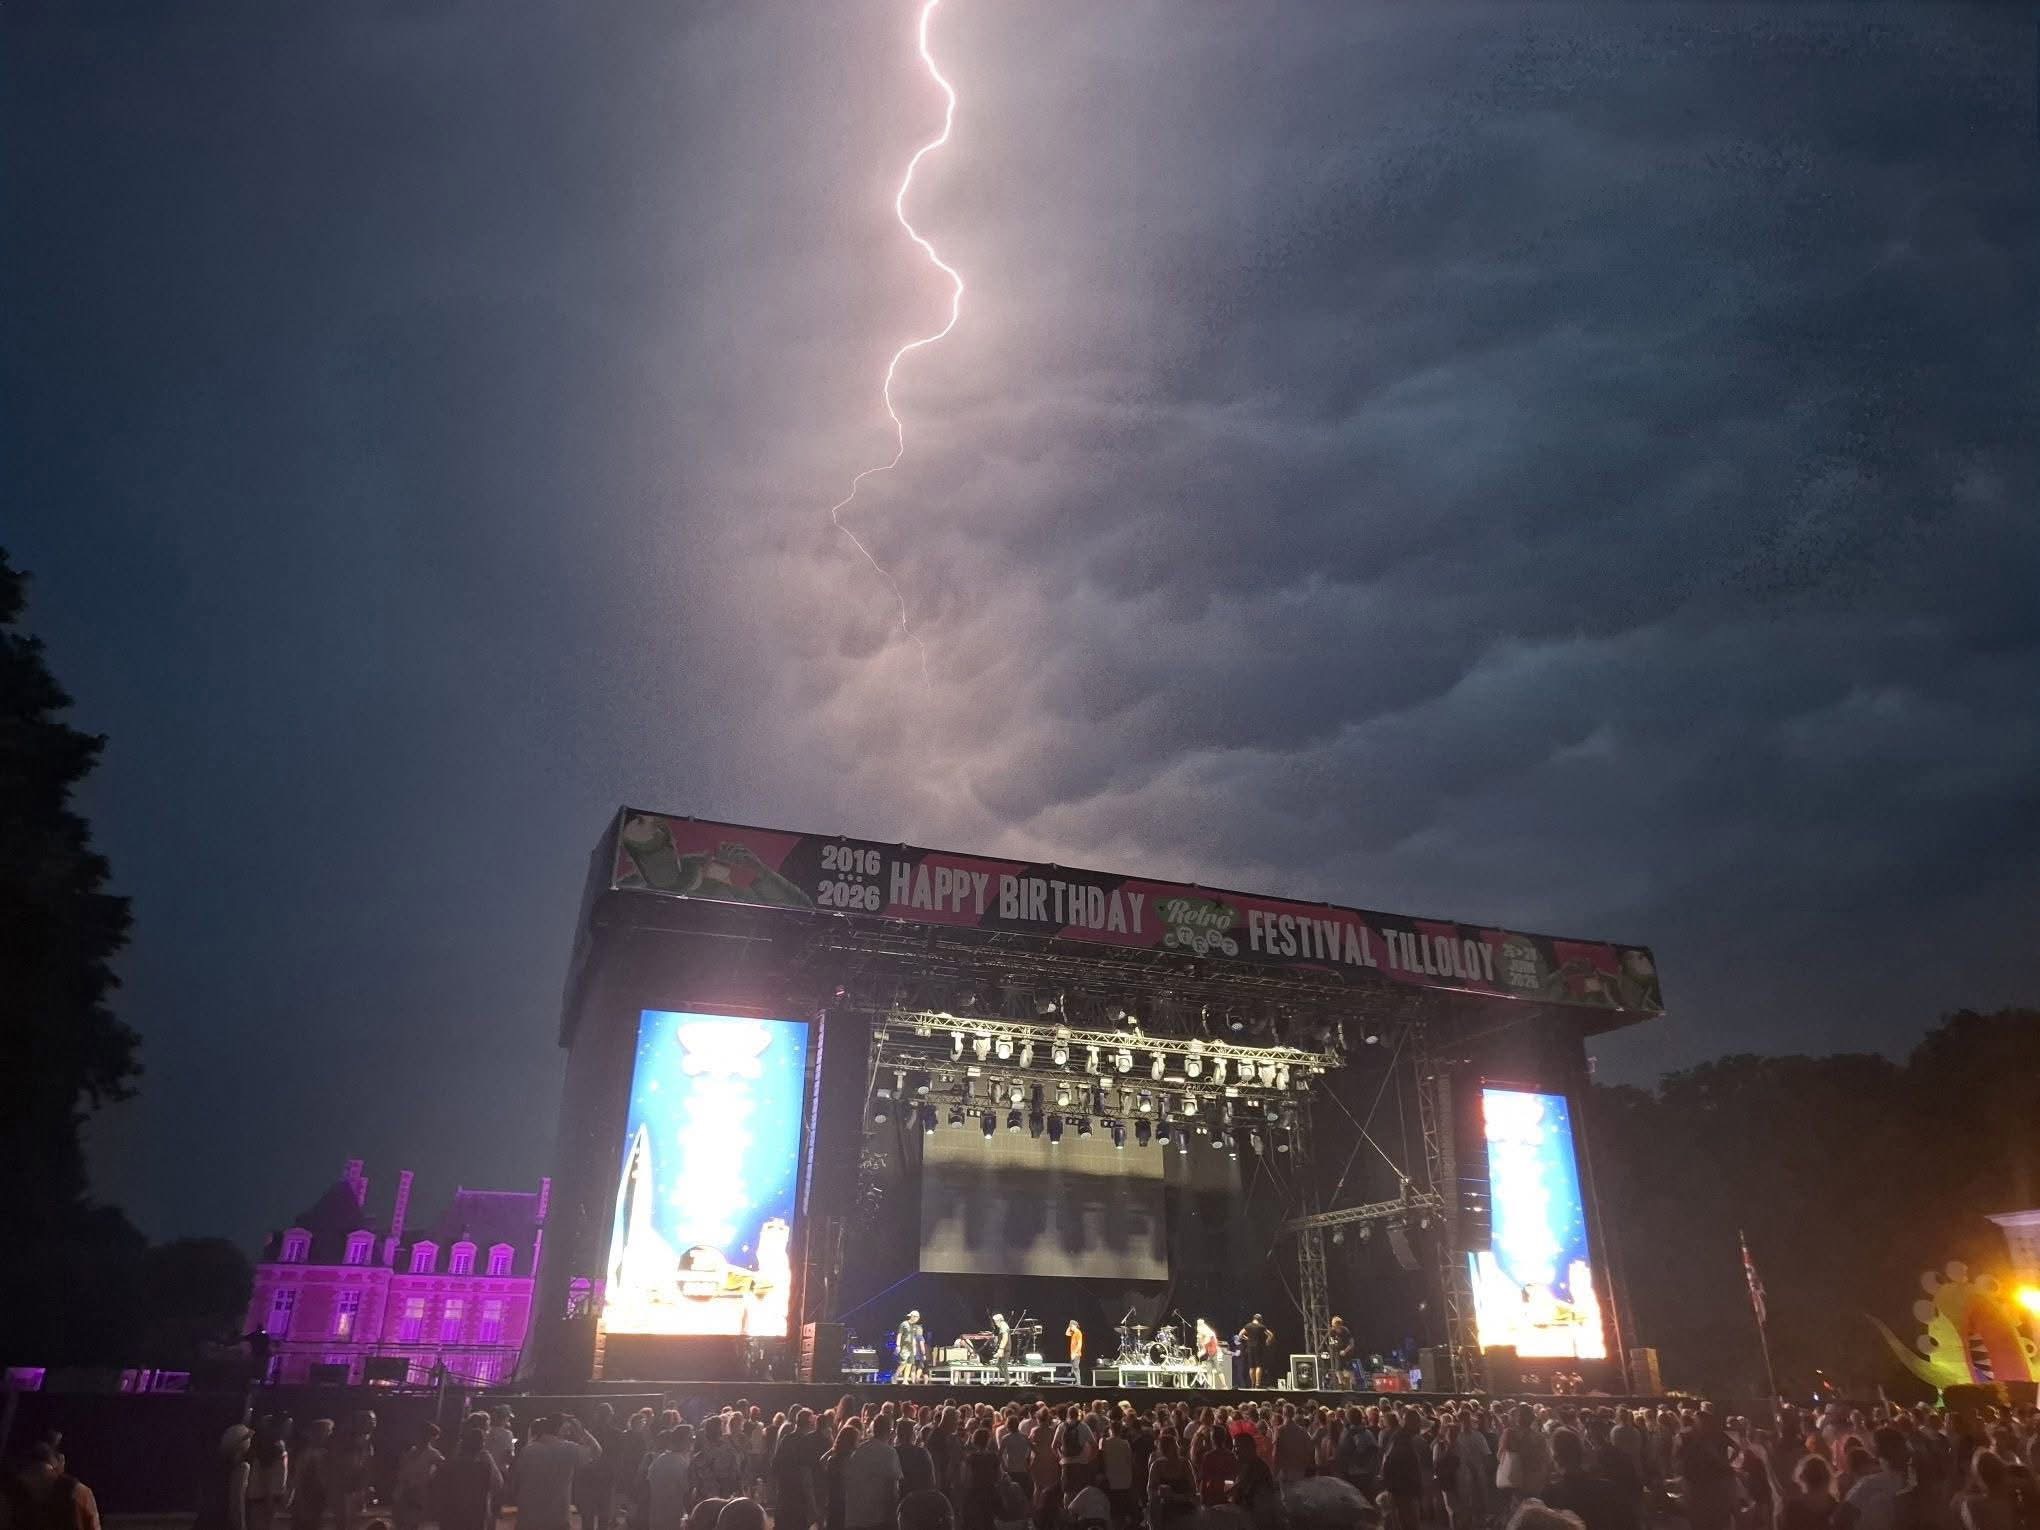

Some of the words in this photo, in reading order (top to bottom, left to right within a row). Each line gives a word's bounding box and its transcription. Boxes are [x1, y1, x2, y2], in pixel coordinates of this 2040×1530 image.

[821, 845, 881, 876] 2016
[817, 880, 880, 911] 2026
[890, 861, 989, 915] HAPPY
[1000, 874, 1145, 934] BIRTHDAY
[1248, 909, 1377, 968] FESTIVAL
[1382, 928, 1493, 981] TILLOLOY
